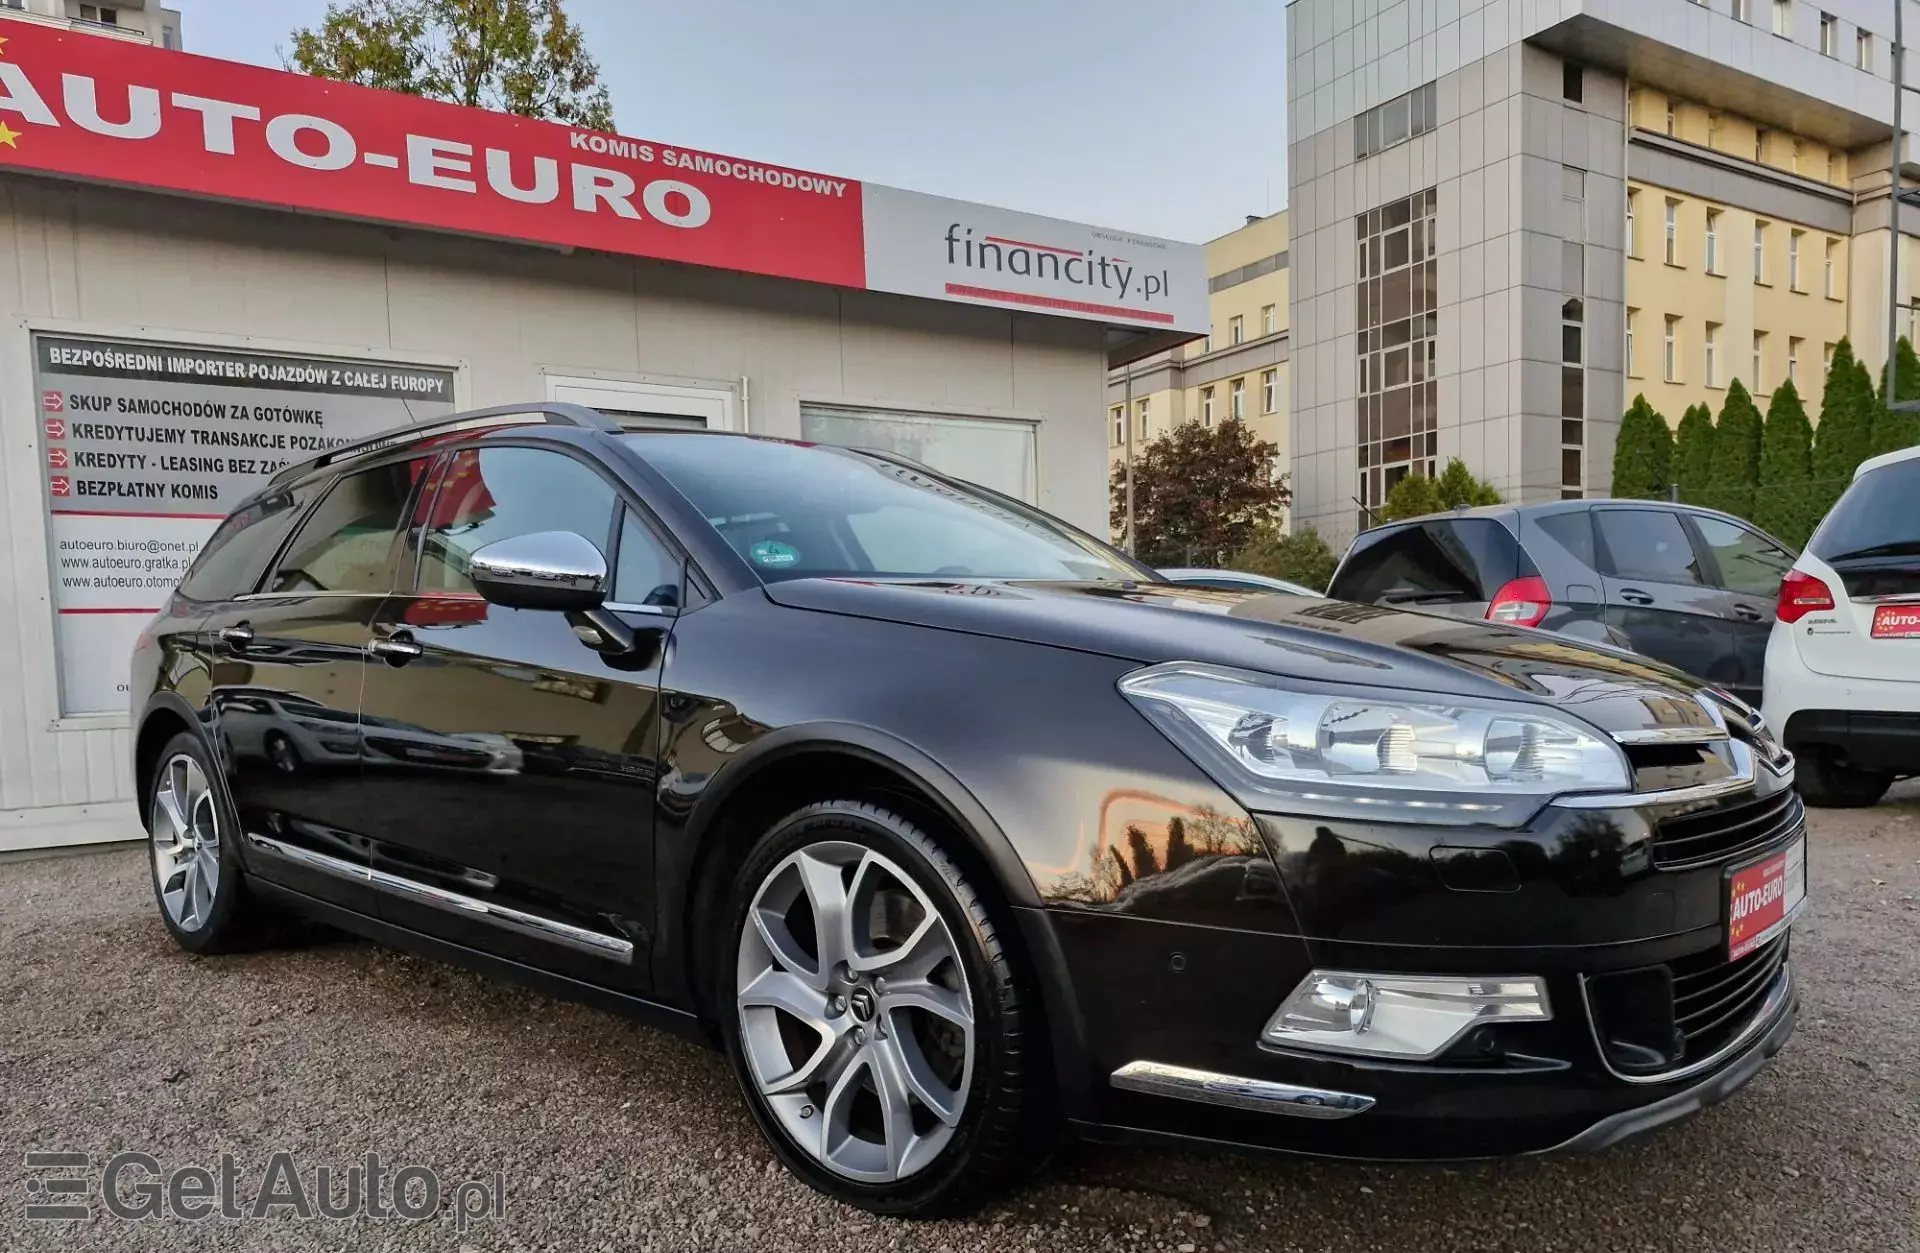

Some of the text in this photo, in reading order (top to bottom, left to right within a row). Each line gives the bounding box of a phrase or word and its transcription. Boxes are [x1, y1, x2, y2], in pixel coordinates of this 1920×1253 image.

[0, 61, 712, 229] AUTO-EURO
[570, 131, 847, 198] KOMIS SAMOCHODOWY
[944, 223, 1169, 302] financity.pl
[50, 347, 444, 394] BEZPOŚREDNI IMPORTER POJAZDÓW Z CAŁEJ EUROPY
[69, 394, 324, 429] SKUP SAMOCHODÓW ZA GOTÓWKĘ
[71, 422, 186, 444] KREDYTUJEMY
[190, 429, 286, 449] TRANSAKCJE
[74, 451, 147, 470] KREDYTY
[160, 455, 224, 473] LEASING
[228, 459, 257, 474] BEZ
[76, 480, 218, 500] BEZPŁATNY KOMIS
[60, 540, 199, 554] autoeuro.biuro@onet.pl
[61, 556, 191, 573] www.autoeuro.gratka.pl
[1732, 875, 1783, 922] AUTO-EURO
